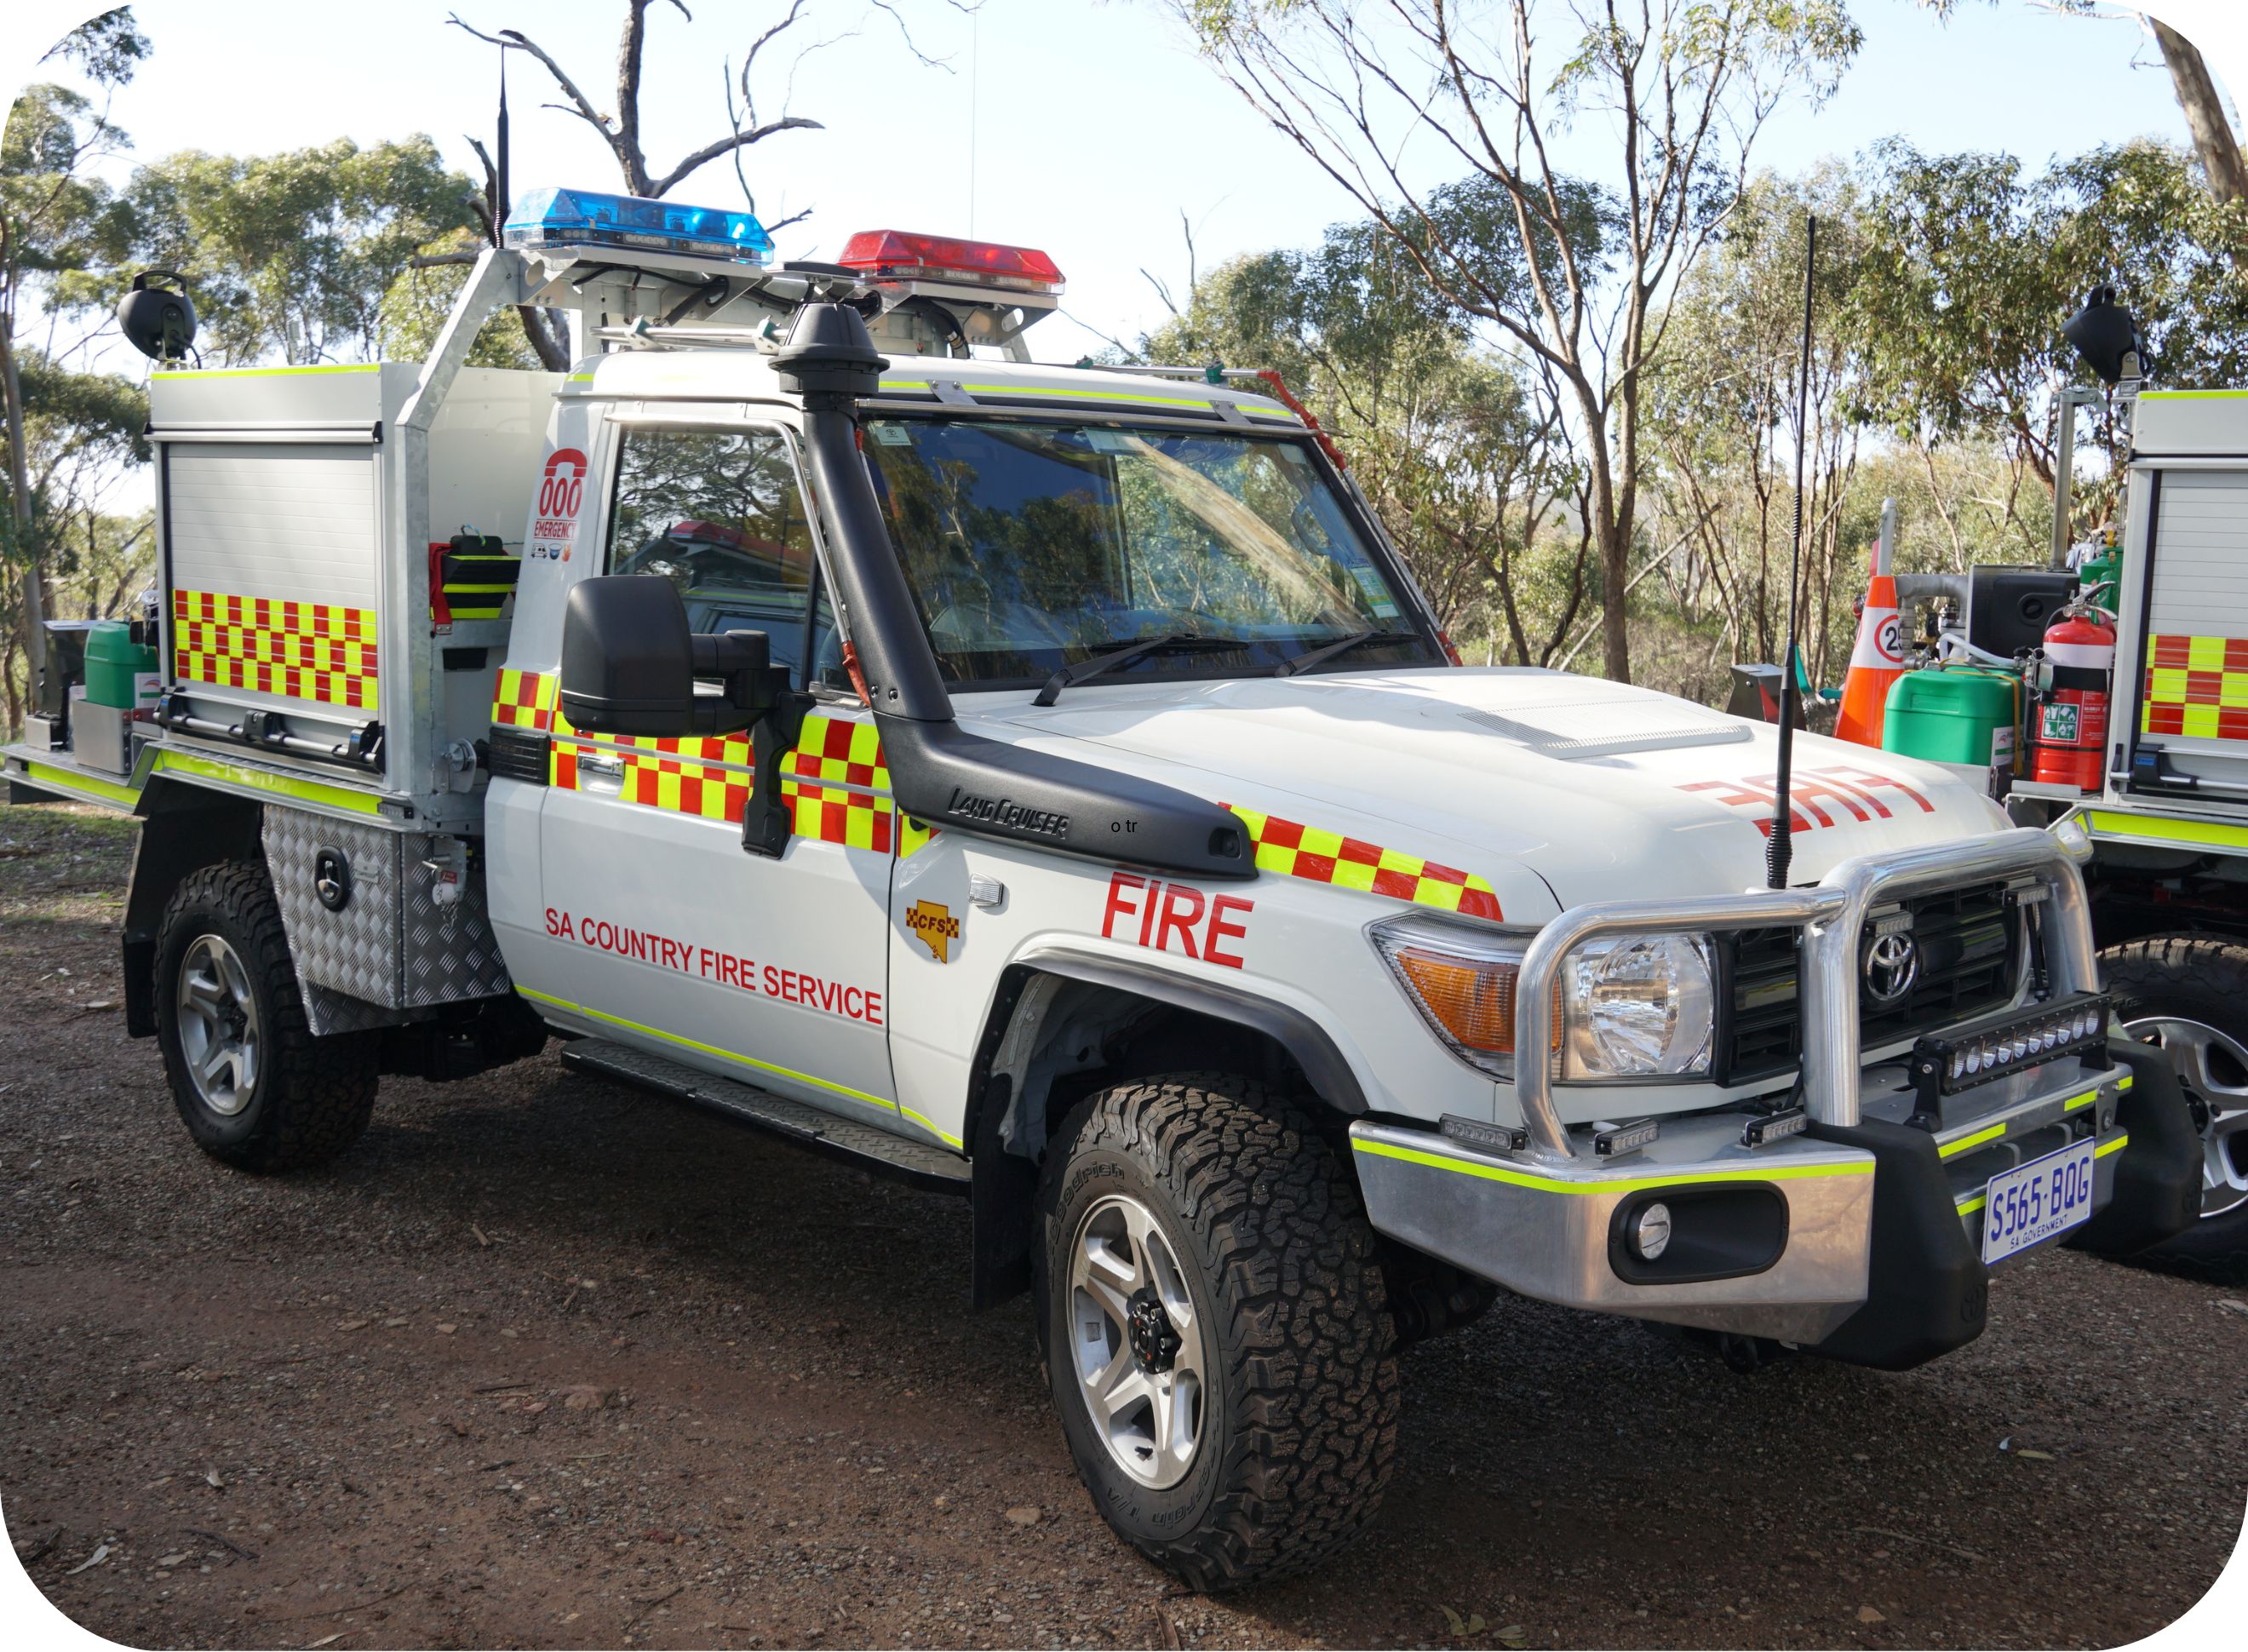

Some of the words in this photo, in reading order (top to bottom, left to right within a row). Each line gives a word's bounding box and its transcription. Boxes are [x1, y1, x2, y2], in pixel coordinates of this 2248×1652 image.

[539, 477, 582, 518] 000
[534, 520, 577, 539] EMERGENCY
[919, 915, 945, 933] CFS
[1101, 871, 1255, 970] FIRE
[546, 908, 575, 940] SA
[581, 917, 694, 972] COUNTRY
[700, 948, 757, 991] FIRE
[763, 965, 884, 1026] SERVICE
[2010, 1236, 2019, 1249] SA
[2022, 1213, 2067, 1243] GOVERNMENT
